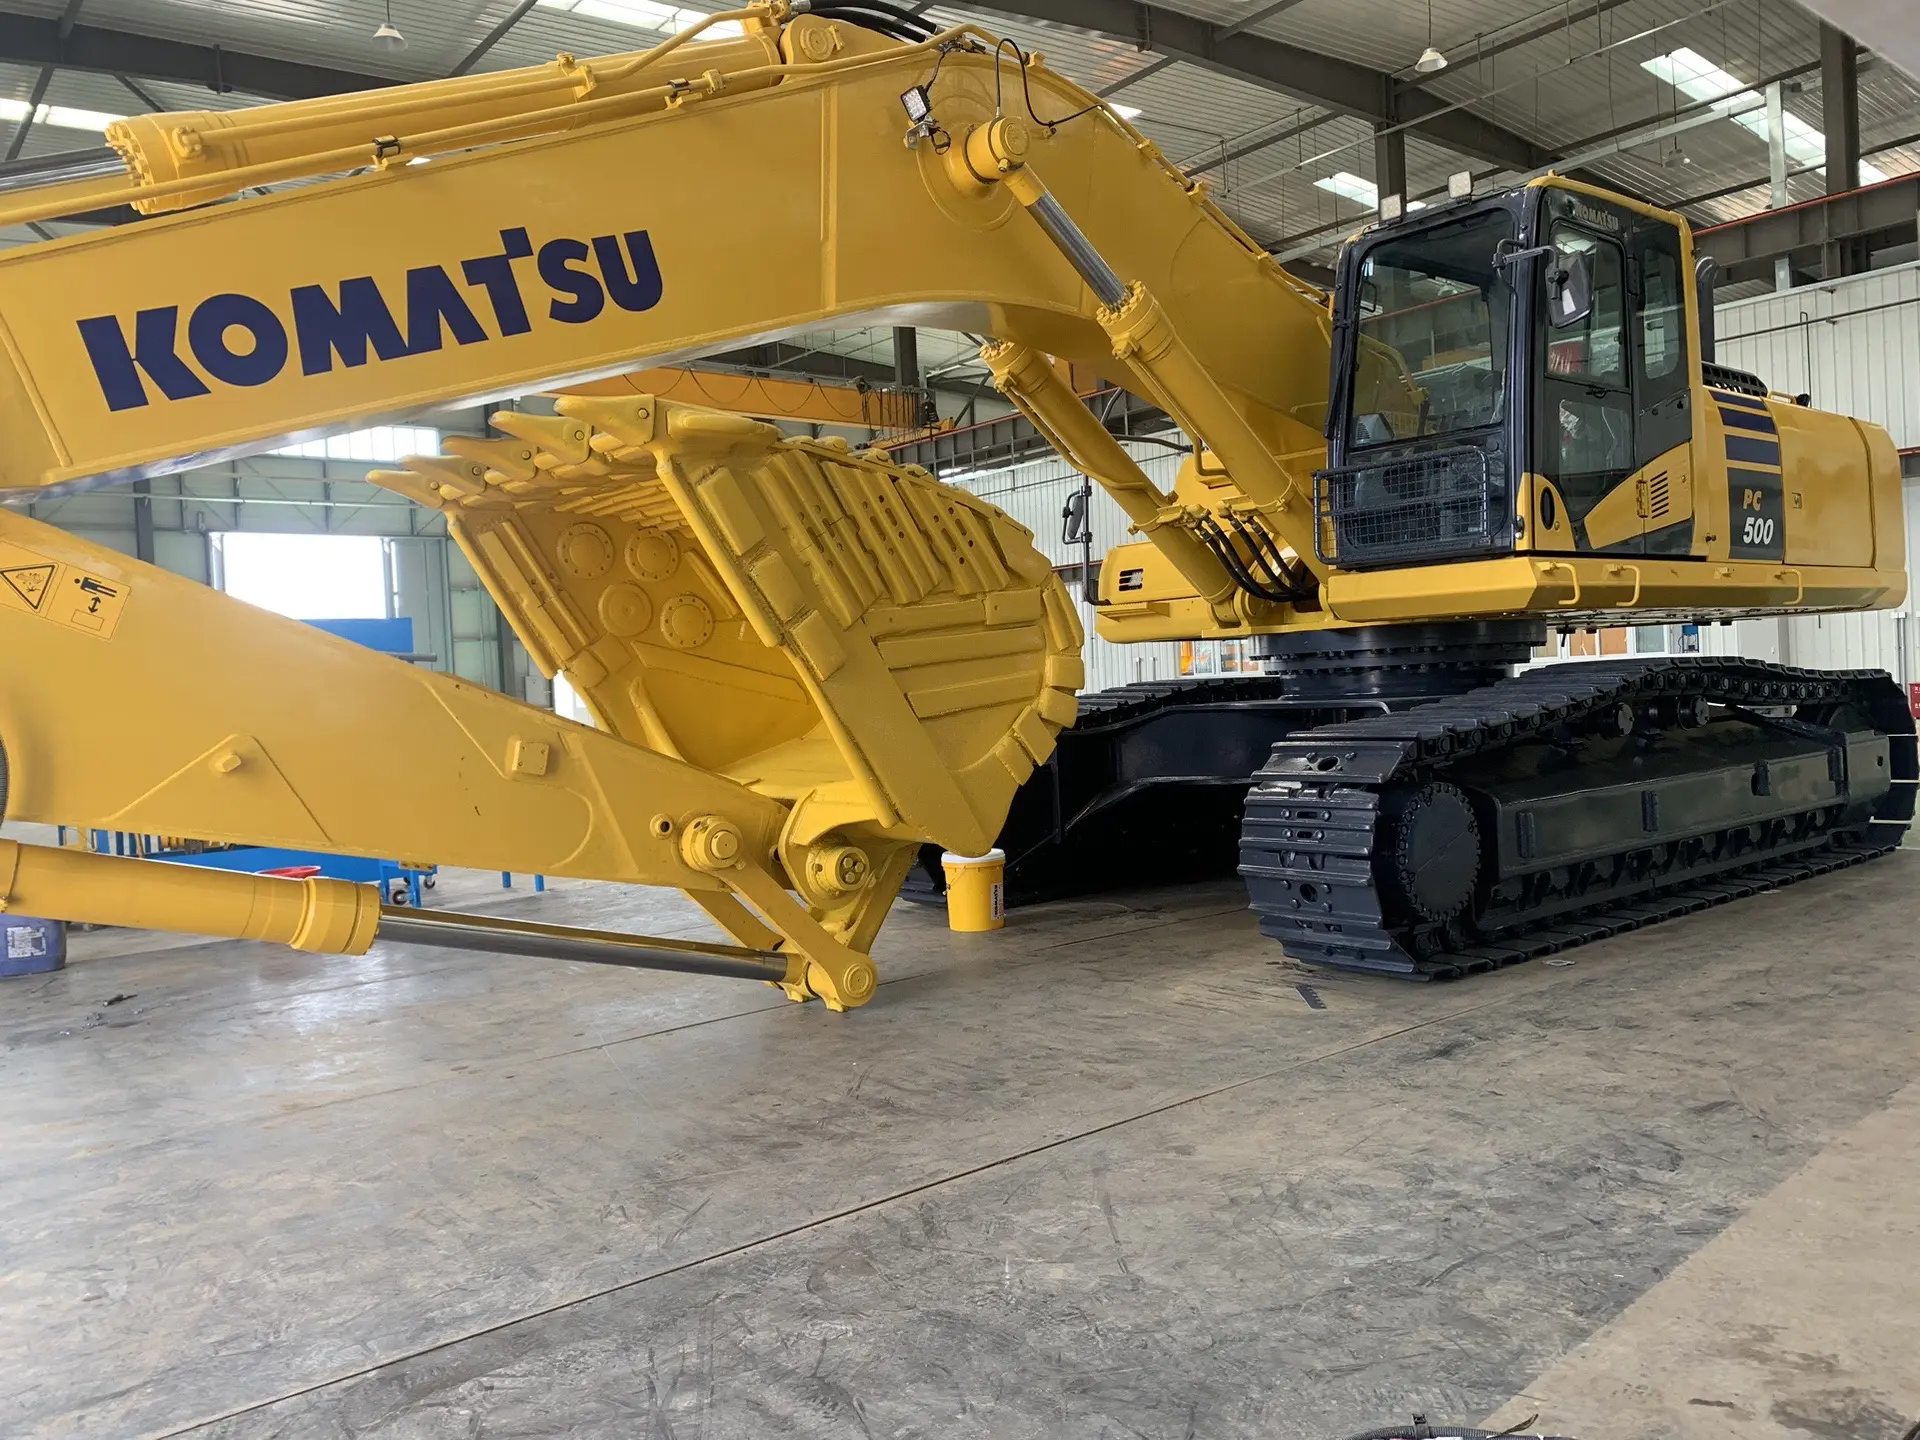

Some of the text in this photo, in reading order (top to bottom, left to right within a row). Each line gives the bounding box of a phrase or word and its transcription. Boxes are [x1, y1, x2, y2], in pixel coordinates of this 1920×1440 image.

[1575, 203, 1619, 231] KOMATSU
[76, 226, 663, 411] KOMATSU
[1743, 488, 1762, 511] PC
[1743, 516, 1774, 545] 500
